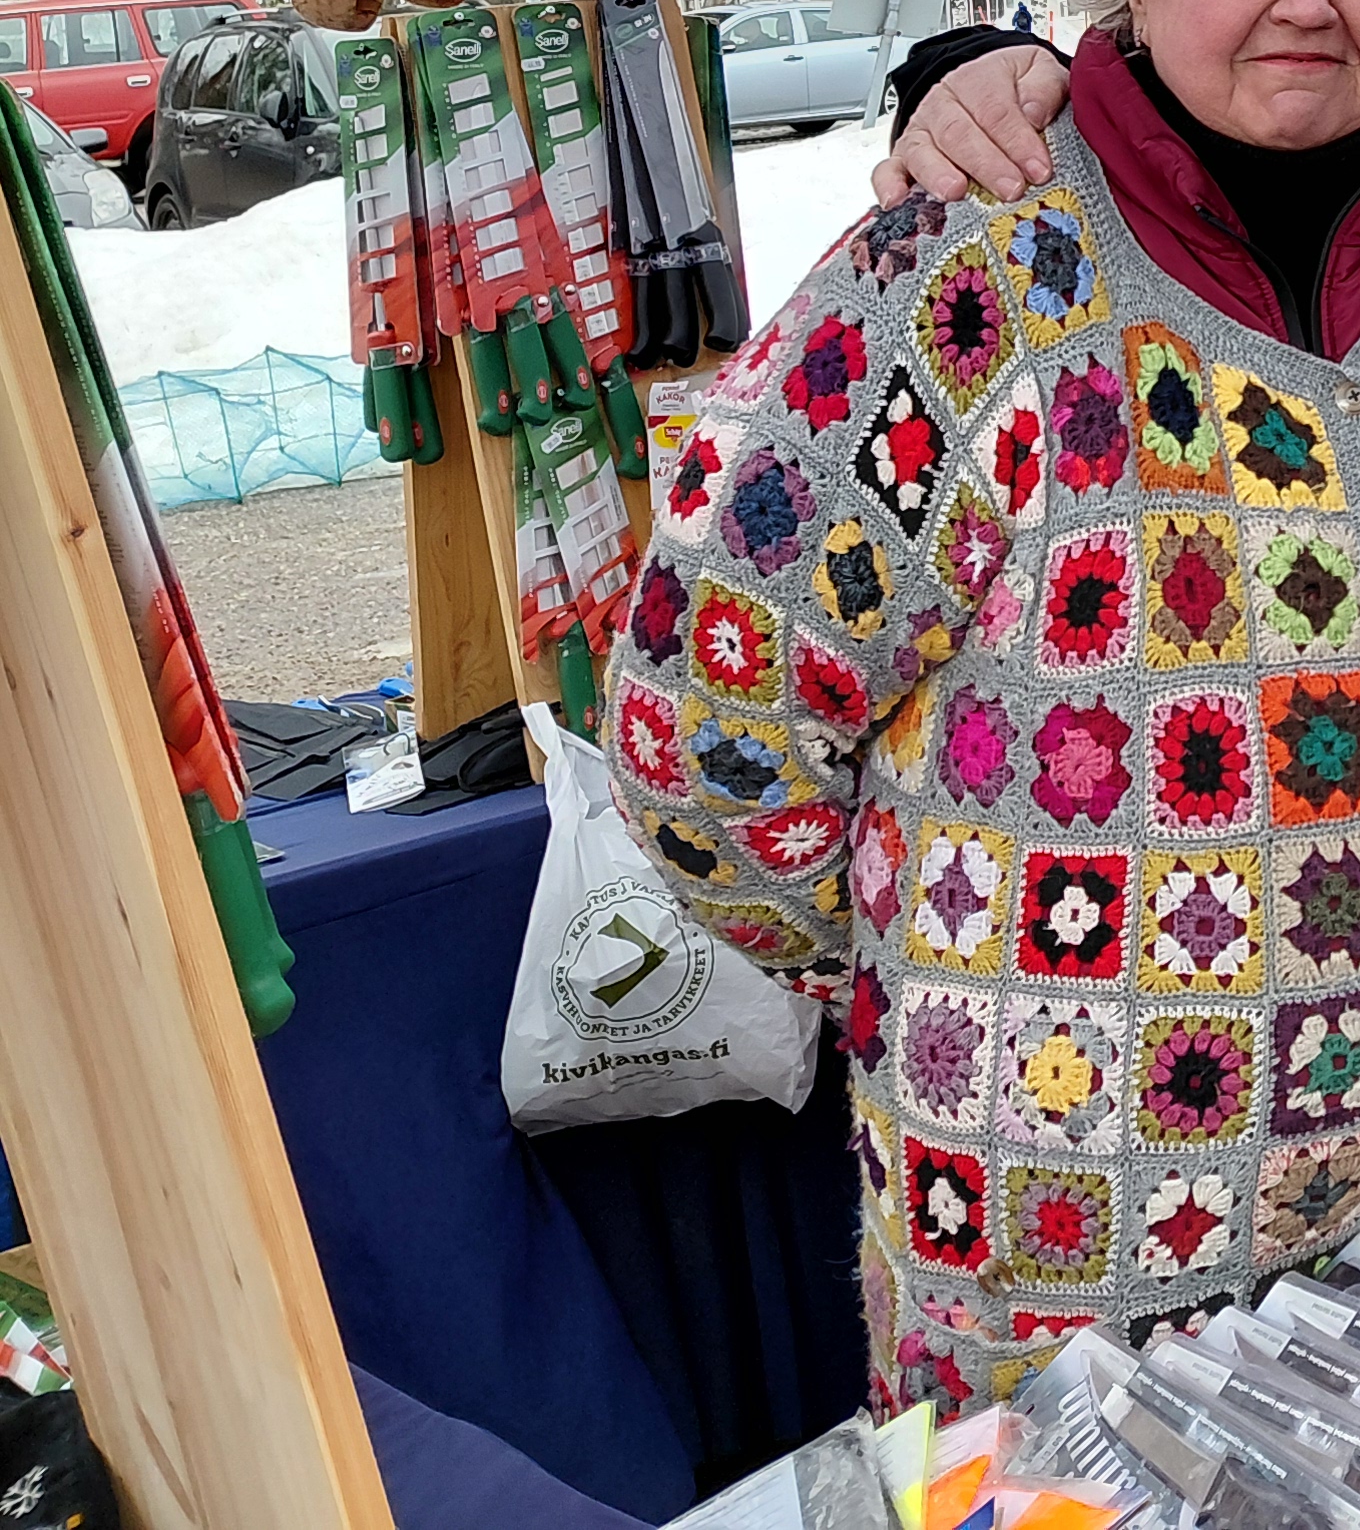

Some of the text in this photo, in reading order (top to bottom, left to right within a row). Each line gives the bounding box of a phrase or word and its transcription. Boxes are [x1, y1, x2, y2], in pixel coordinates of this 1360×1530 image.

[445, 42, 482, 57] Sanelli
[535, 32, 570, 48] Sanelli
[556, 948, 706, 1036] KASVIHUONEET JA TARVIKKEET
[542, 1038, 731, 1084] kivikangas.fi
